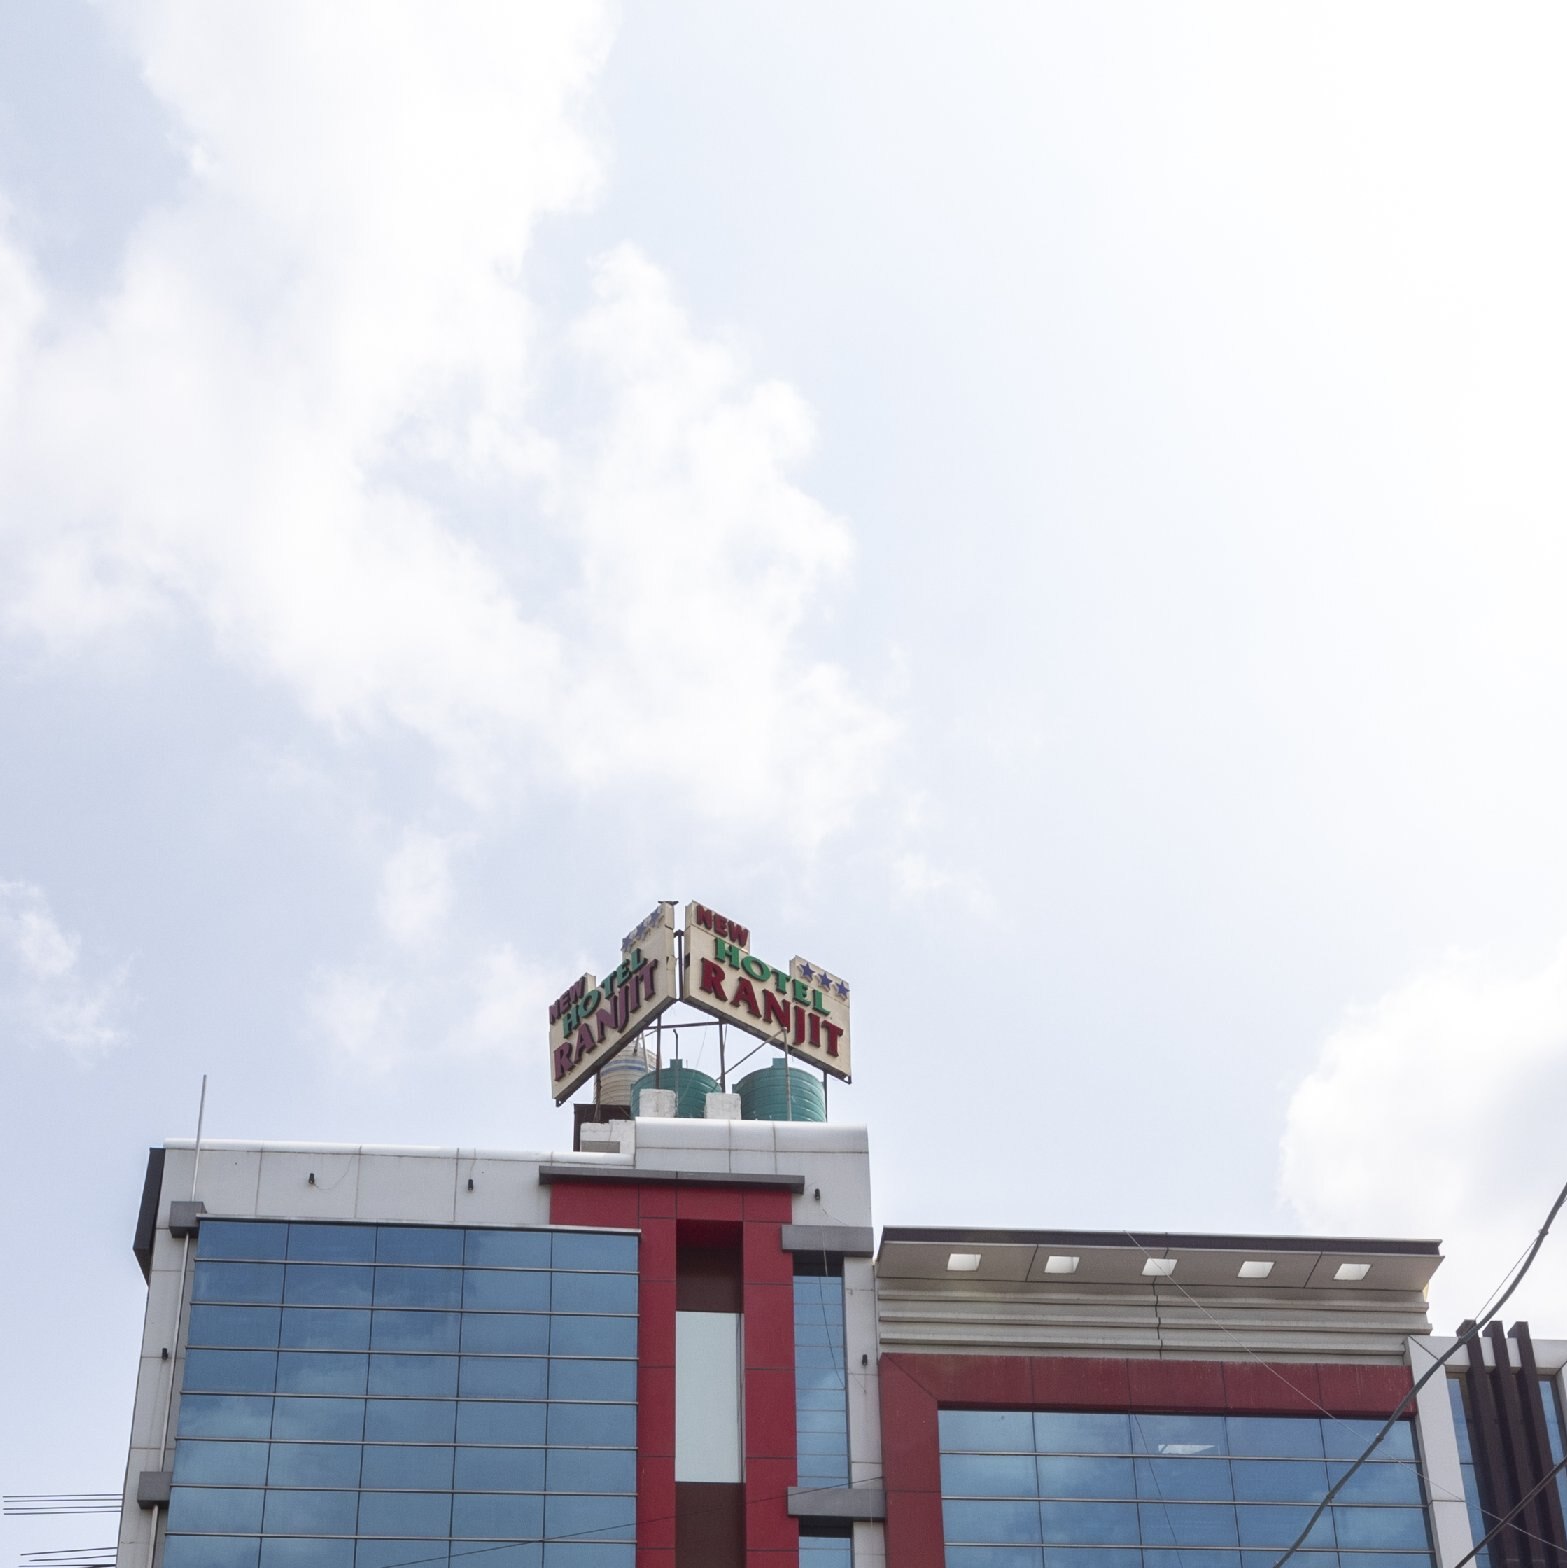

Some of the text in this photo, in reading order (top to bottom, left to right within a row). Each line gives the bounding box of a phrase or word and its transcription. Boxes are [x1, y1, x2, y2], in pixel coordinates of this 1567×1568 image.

[697, 905, 749, 948] NEW
[549, 976, 586, 1026] NEW
[563, 948, 649, 1039] HOTEL
[699, 957, 844, 1058] RANJIT
[715, 937, 830, 1015] HOTEL
[553, 958, 658, 1082] RANJIT
